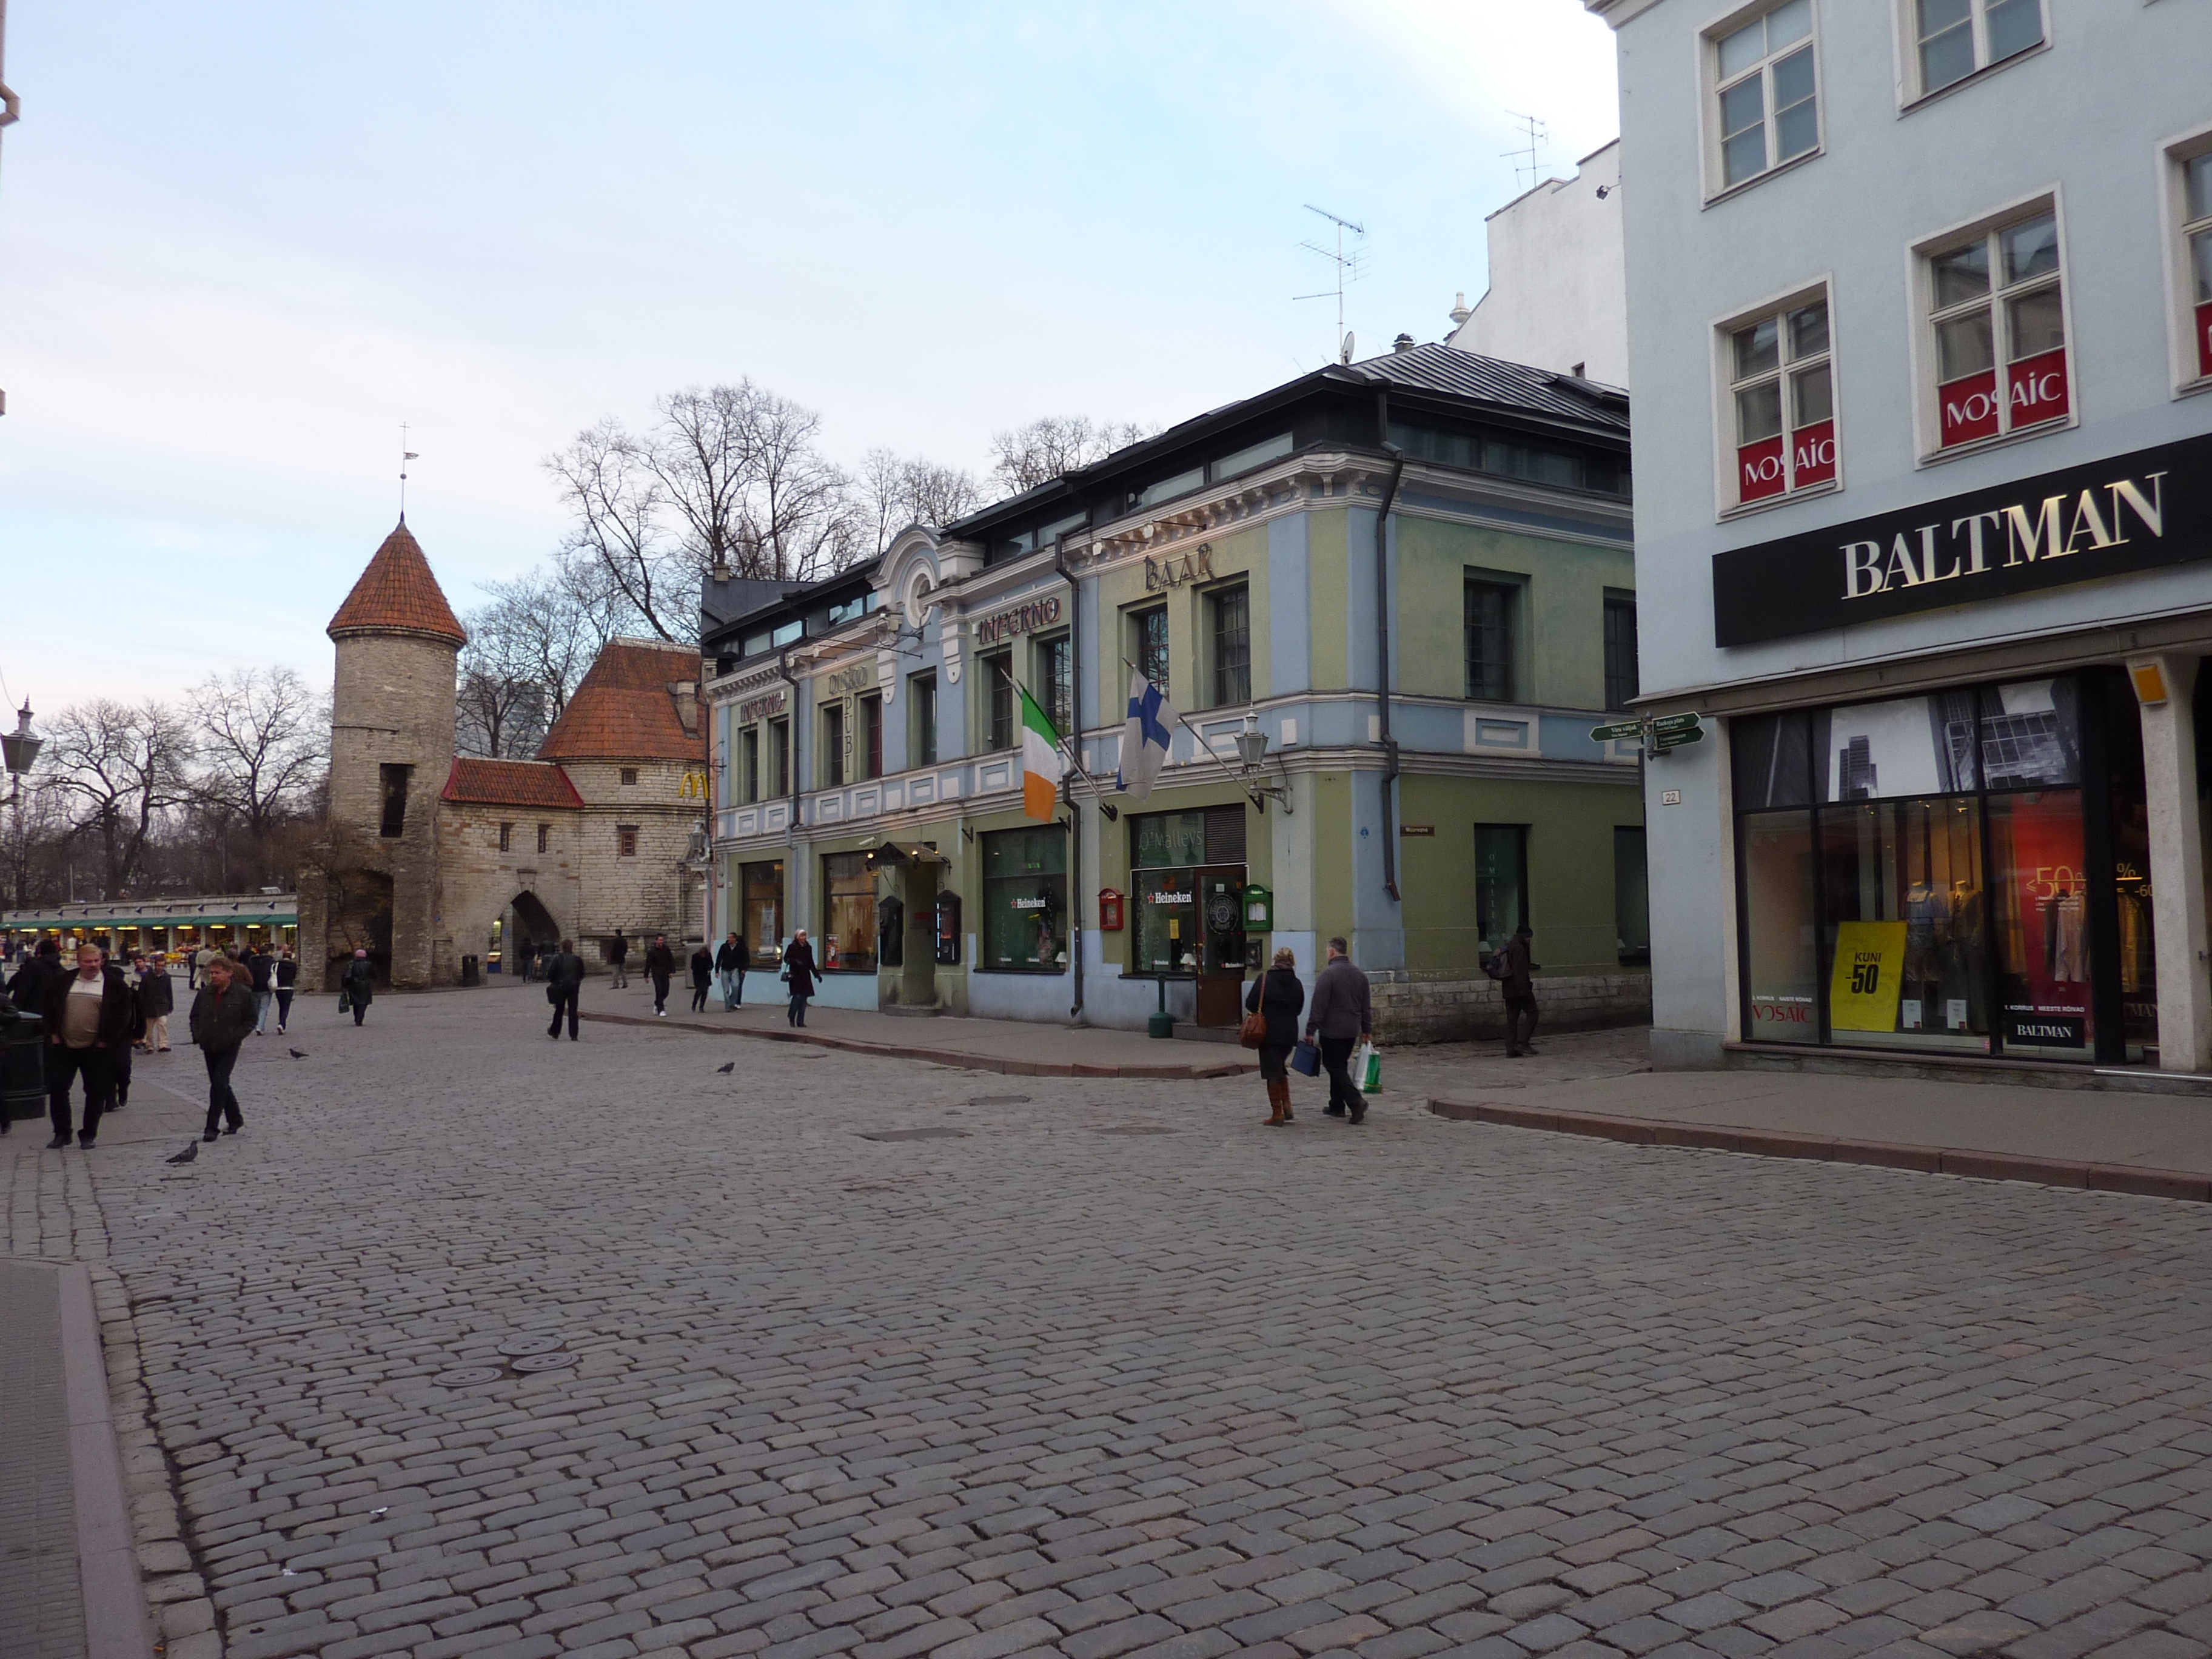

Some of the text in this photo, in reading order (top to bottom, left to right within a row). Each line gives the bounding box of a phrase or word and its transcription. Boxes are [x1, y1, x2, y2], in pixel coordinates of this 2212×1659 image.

[1838, 471, 2169, 600] BALTMAN
[1144, 543, 1216, 592] BAAR
[979, 597, 1061, 645] INFERNO
[1666, 793, 1676, 802] 22
[1017, 897, 1045, 908] Heineken
[1155, 891, 1192, 903] Heineken
[1855, 952, 1882, 962] KUNI
[1845, 964, 1879, 994] -50
[2017, 1024, 2073, 1037] BALTMAN
